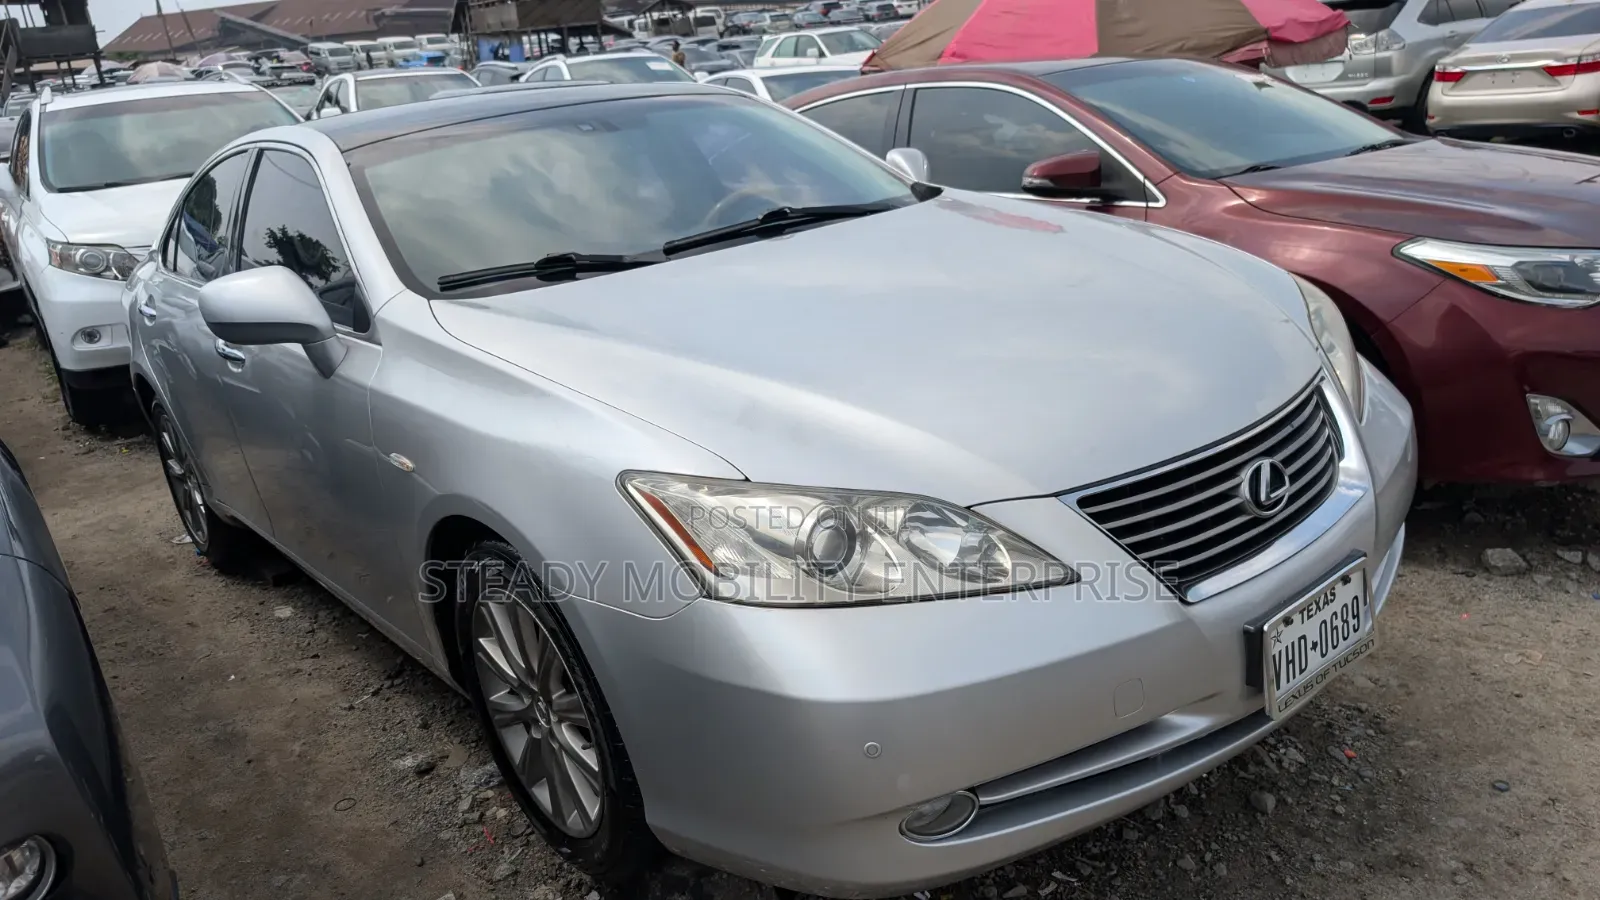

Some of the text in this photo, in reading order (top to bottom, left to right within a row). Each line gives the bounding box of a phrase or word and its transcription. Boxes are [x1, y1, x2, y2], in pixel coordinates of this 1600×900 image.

[1299, 586, 1337, 624] TEXAS
[1278, 638, 1375, 713] LEXUS OF TUCSON
